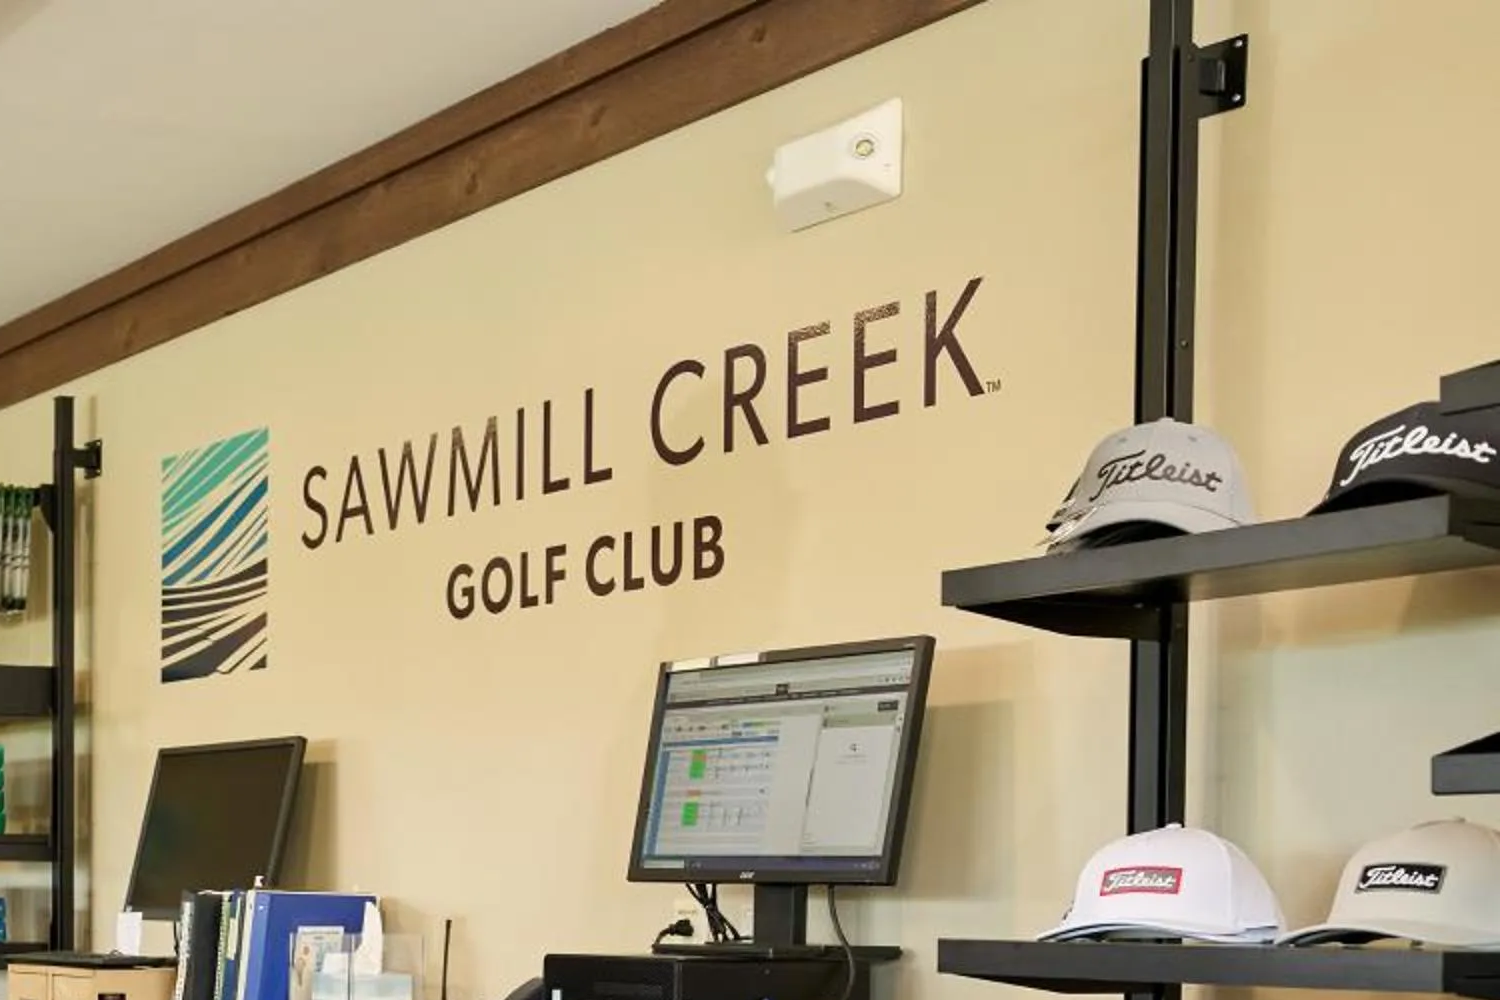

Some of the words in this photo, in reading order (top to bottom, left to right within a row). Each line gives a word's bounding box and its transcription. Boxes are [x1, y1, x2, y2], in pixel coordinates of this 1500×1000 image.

[301, 388, 613, 550] SAWMILL
[650, 276, 985, 466] CREEK
[1088, 449, 1223, 502] Titleist
[1339, 424, 1498, 487] Titleist
[446, 543, 567, 620] GOLF
[585, 514, 726, 597] CLUB
[1104, 869, 1176, 892] Titleist
[1359, 865, 1439, 889] Titleist
